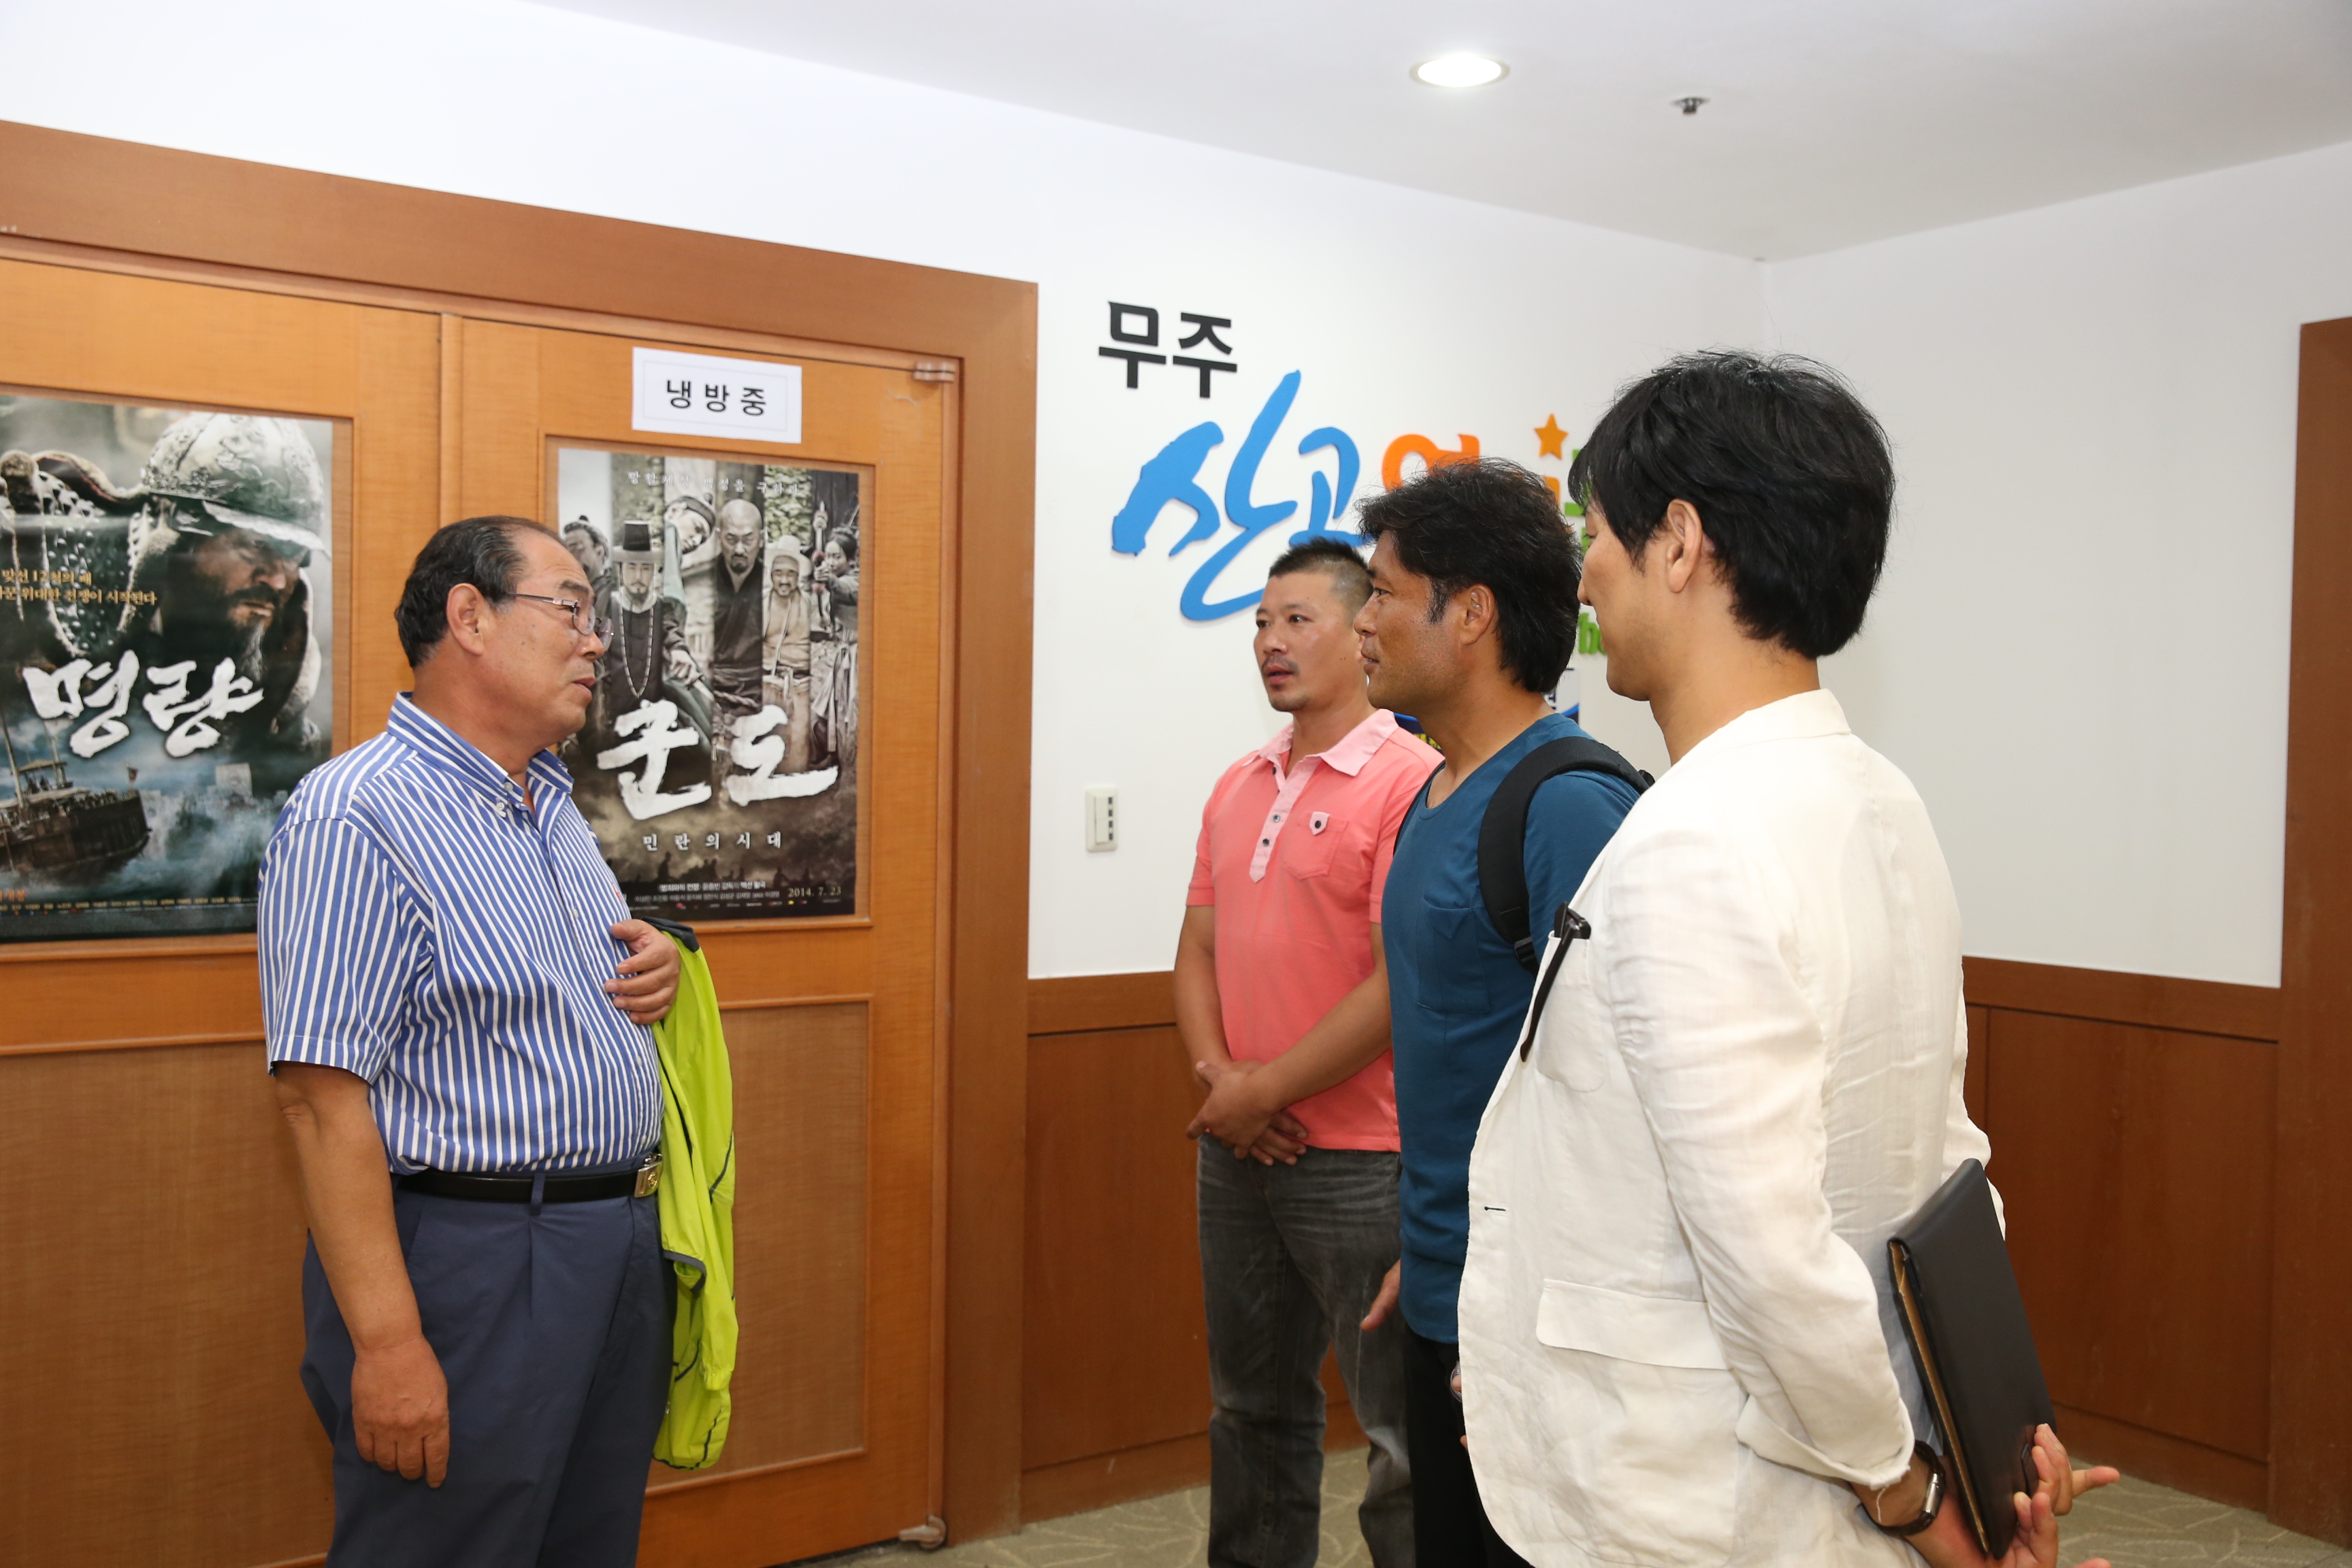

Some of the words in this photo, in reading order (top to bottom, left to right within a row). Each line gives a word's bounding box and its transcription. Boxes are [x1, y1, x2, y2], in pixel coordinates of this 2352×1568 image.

[666, 378, 768, 418] 냉방중
[1098, 301, 1238, 399] 무주
[22, 649, 264, 759] 명량
[596, 699, 838, 819] 군도
[830, 886, 843, 896] 23
